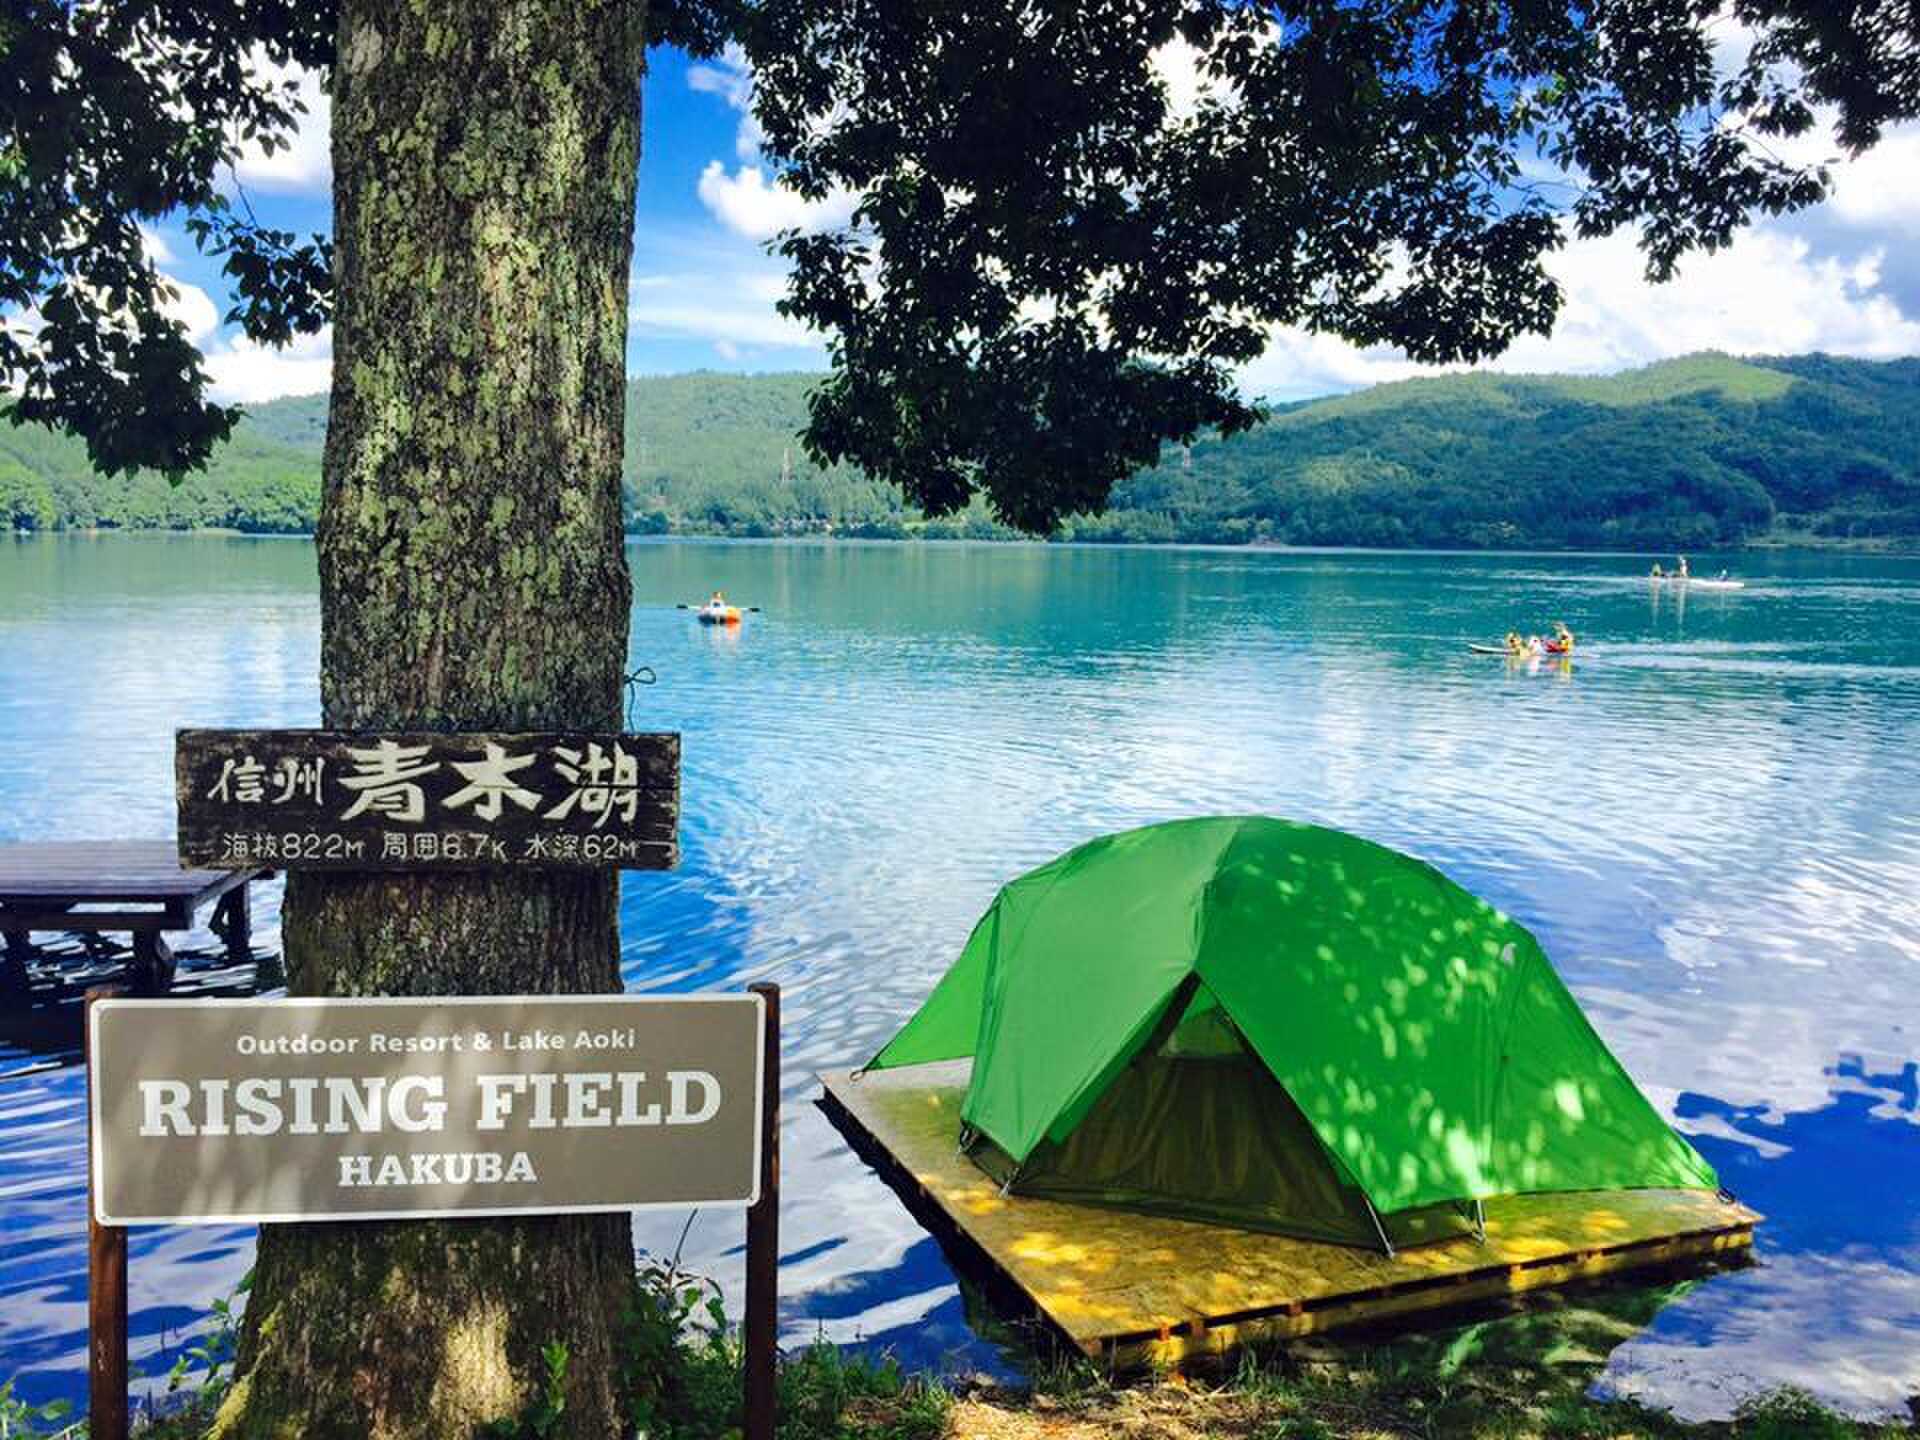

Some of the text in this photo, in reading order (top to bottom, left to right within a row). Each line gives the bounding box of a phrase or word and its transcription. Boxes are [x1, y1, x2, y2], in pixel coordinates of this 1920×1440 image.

[208, 740, 641, 829] 信州 青木湖
[236, 1029, 636, 1056] Outdoor Resort & Lake Aoki
[138, 1070, 722, 1137] RISING FIELD
[338, 1151, 538, 1188] HAKUBA
